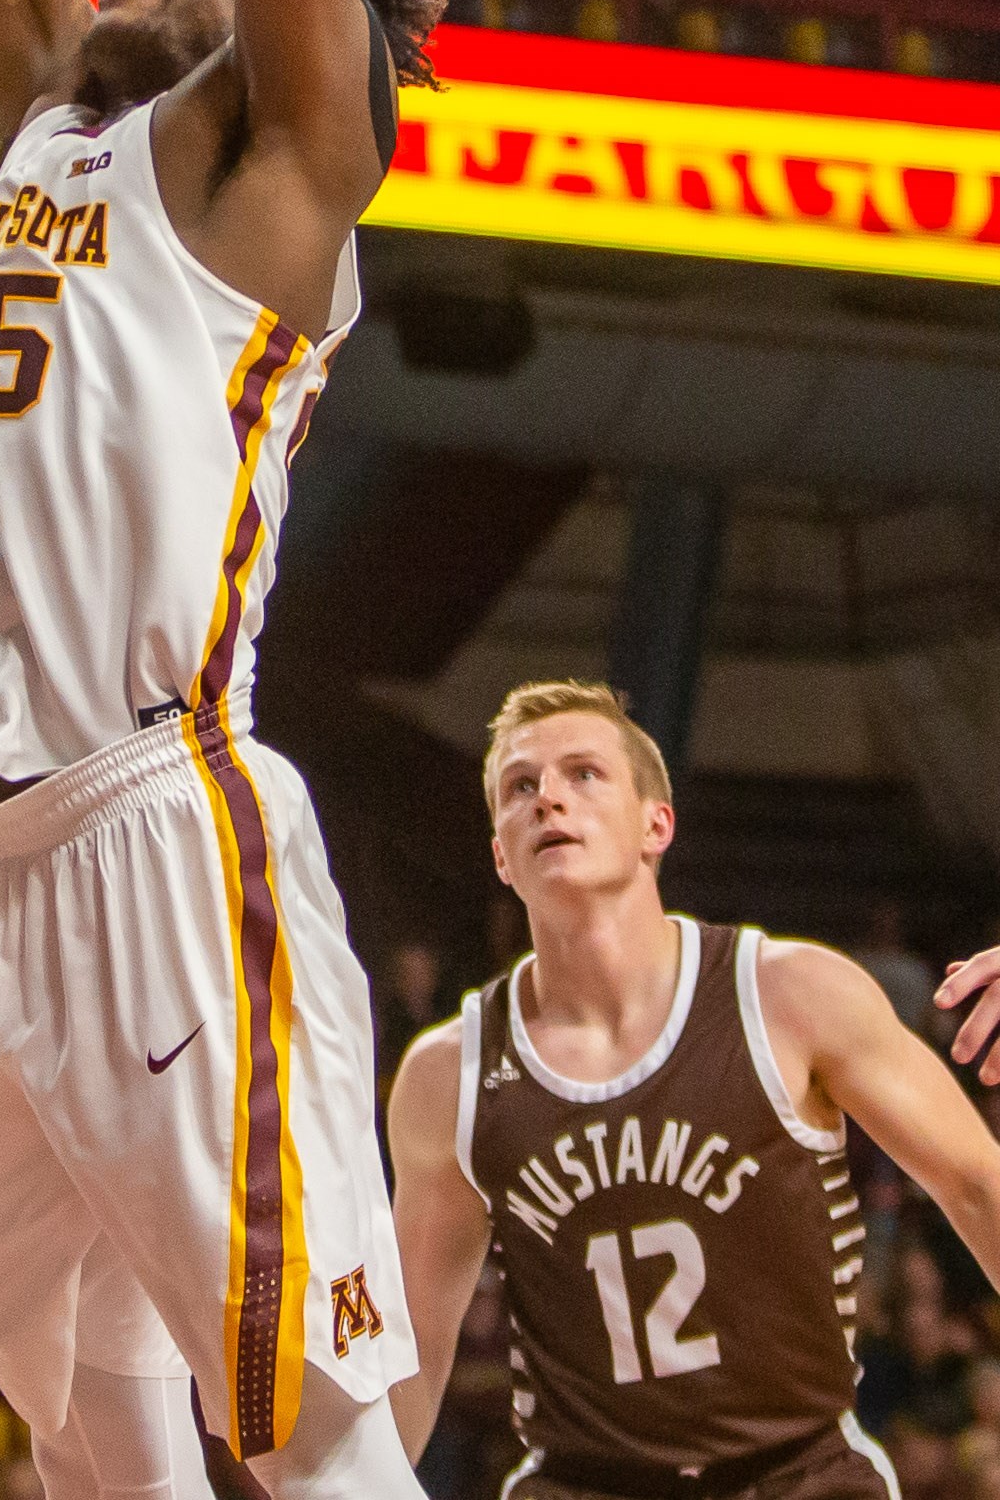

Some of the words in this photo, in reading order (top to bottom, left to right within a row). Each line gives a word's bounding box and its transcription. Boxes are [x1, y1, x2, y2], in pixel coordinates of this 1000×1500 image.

[506, 1117, 759, 1245] MUSTANGS
[330, 1263, 384, 1360] M
[586, 1219, 720, 1384] 12
